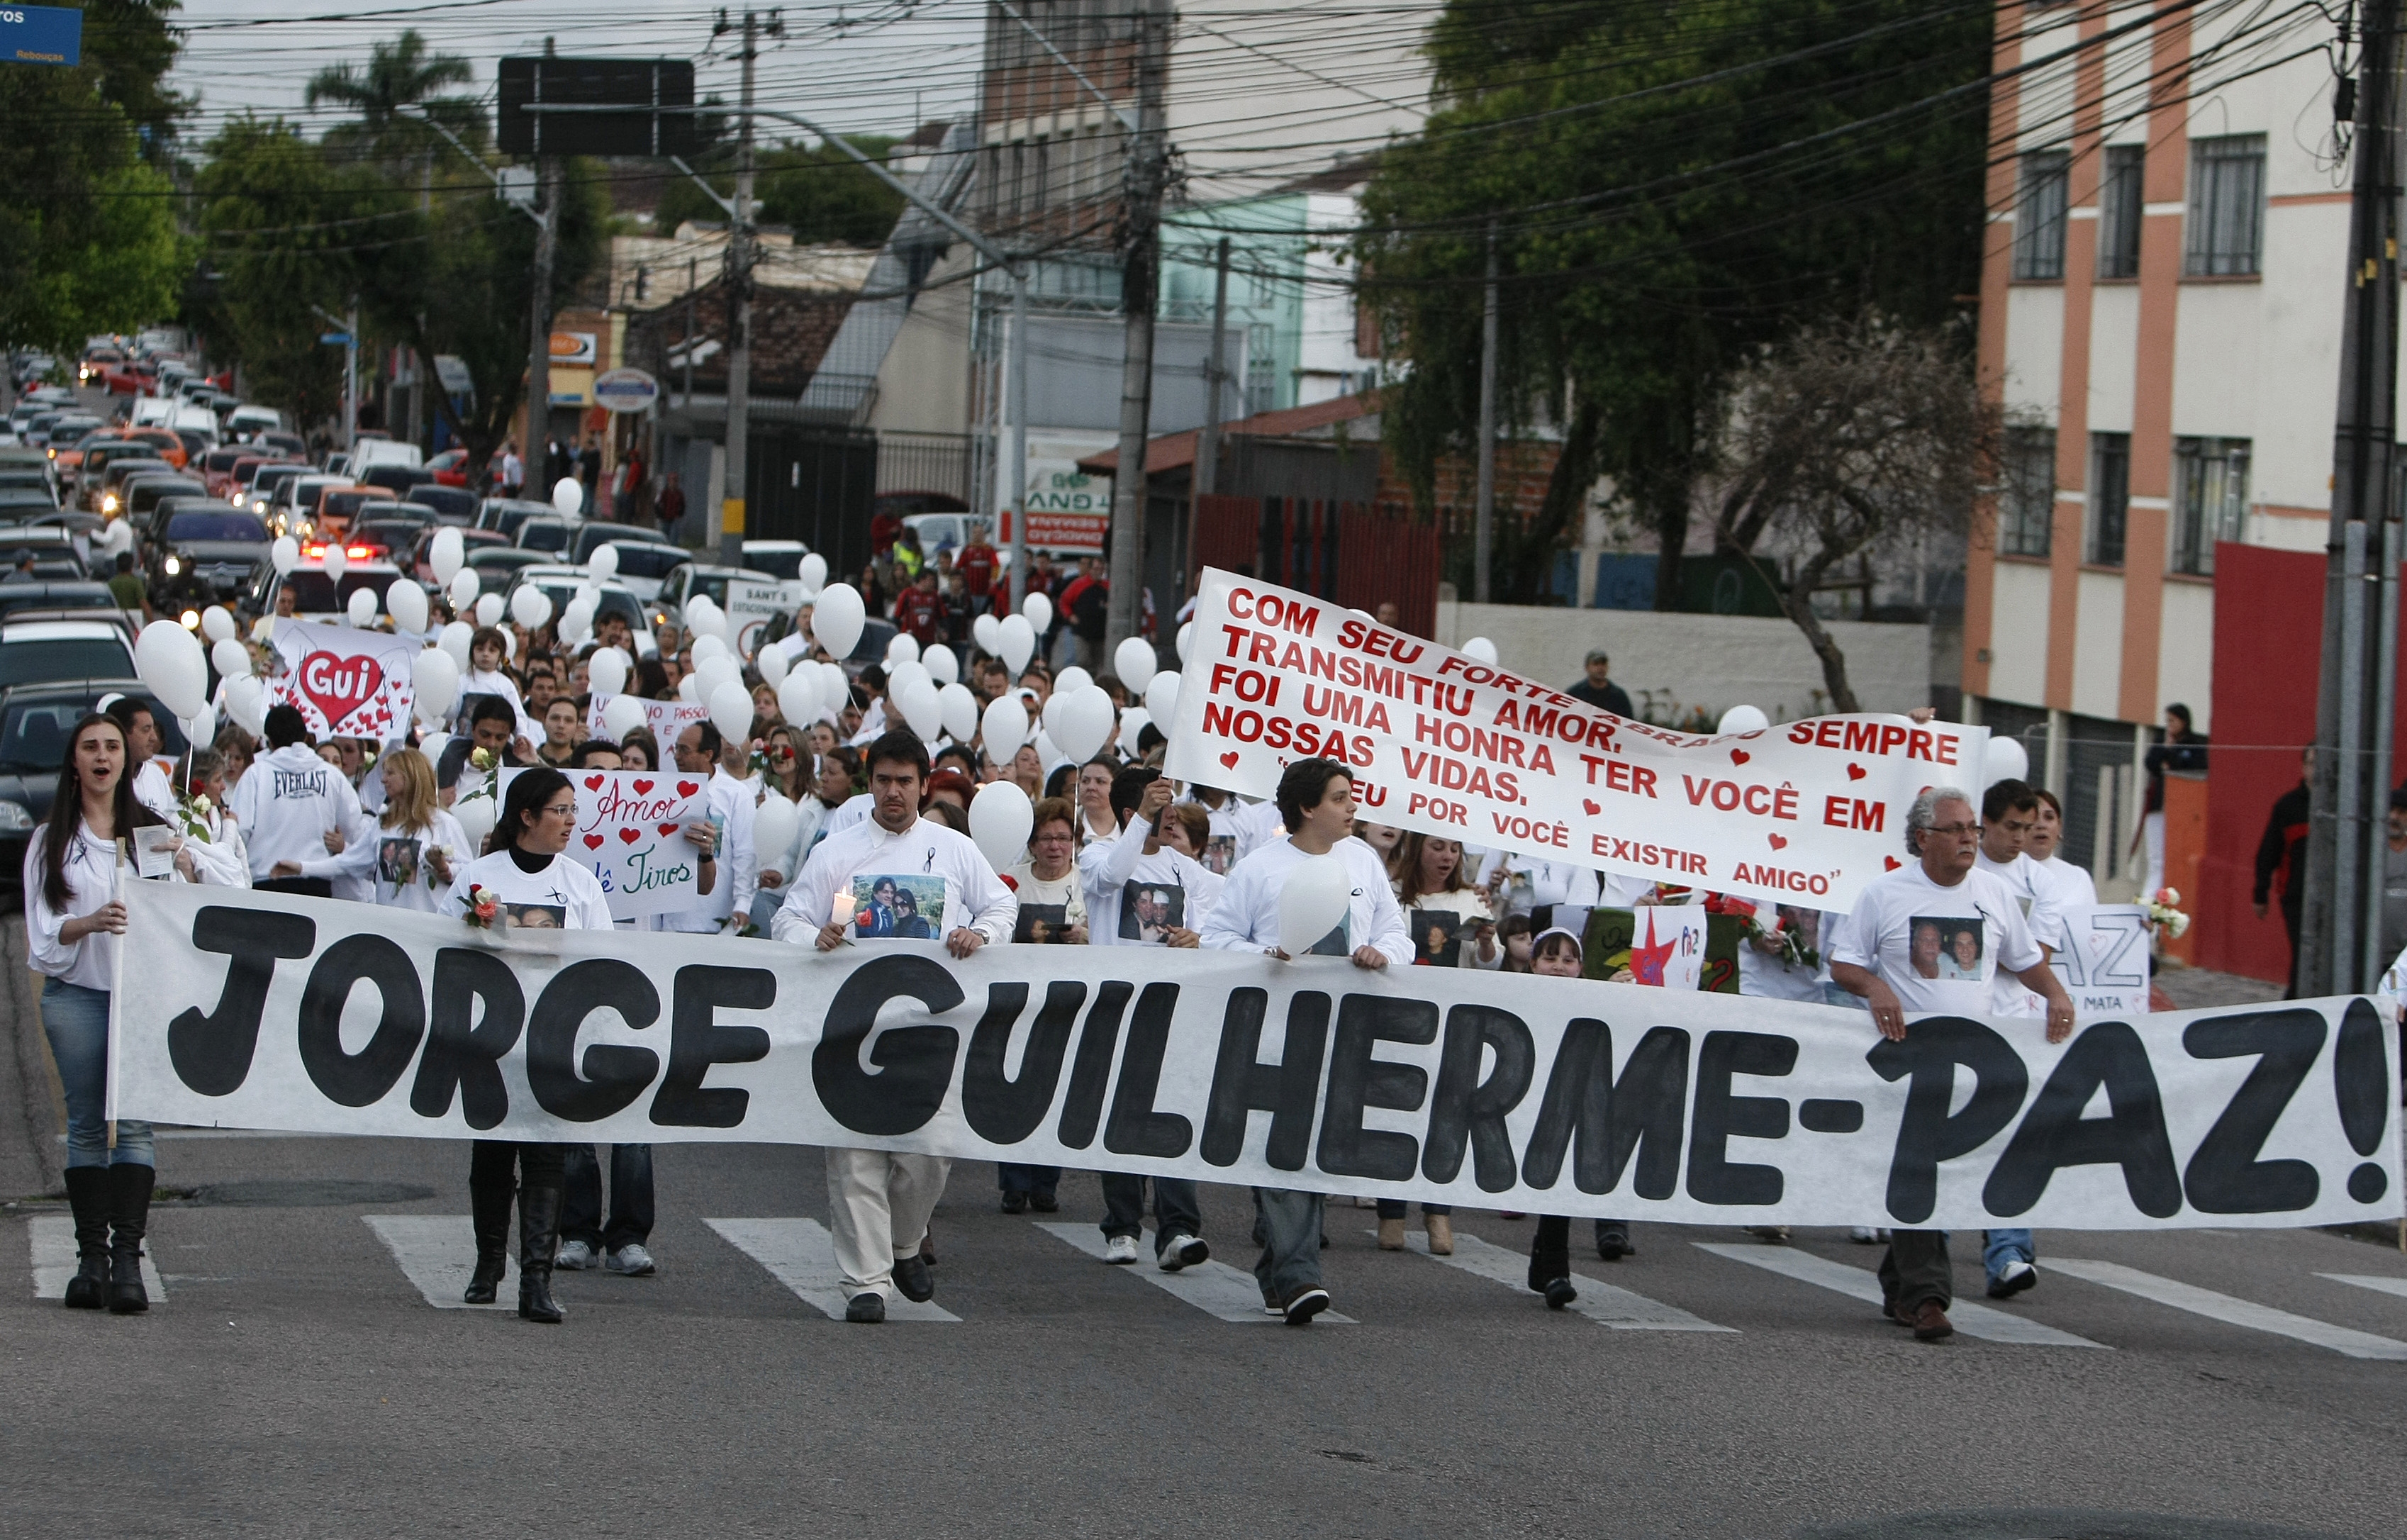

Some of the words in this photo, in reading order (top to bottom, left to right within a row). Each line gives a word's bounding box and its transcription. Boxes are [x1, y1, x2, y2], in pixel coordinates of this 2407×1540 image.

[17, 50, 65, 62] Rebouças
[306, 657, 371, 701] Gui
[1222, 624, 1475, 716] TRANSMITIU
[1228, 588, 1320, 637] COM
[1337, 620, 1424, 664] SEU
[1437, 656, 1578, 708] FORTE
[1787, 720, 1960, 766] SEMPRE
[1202, 701, 1375, 767] NOSSAS
[1401, 746, 1527, 806] VIDAS.
[1210, 663, 1281, 707] FOI
[1303, 683, 1392, 735] UMA
[1416, 713, 1556, 776] HONRA
[1580, 753, 1658, 799] TER
[1682, 774, 1799, 820] VOCÊ
[1824, 795, 1886, 832] EM
[273, 770, 328, 800] EVERLAST
[580, 778, 688, 832] Amor
[622, 843, 693, 894] Tiros
[1408, 793, 1468, 826] POR
[1492, 813, 1569, 849] VOCÊ
[1592, 833, 1708, 876] EXISTIR
[168, 906, 777, 1137] JORGE
[2084, 995, 2123, 1011] MATA
